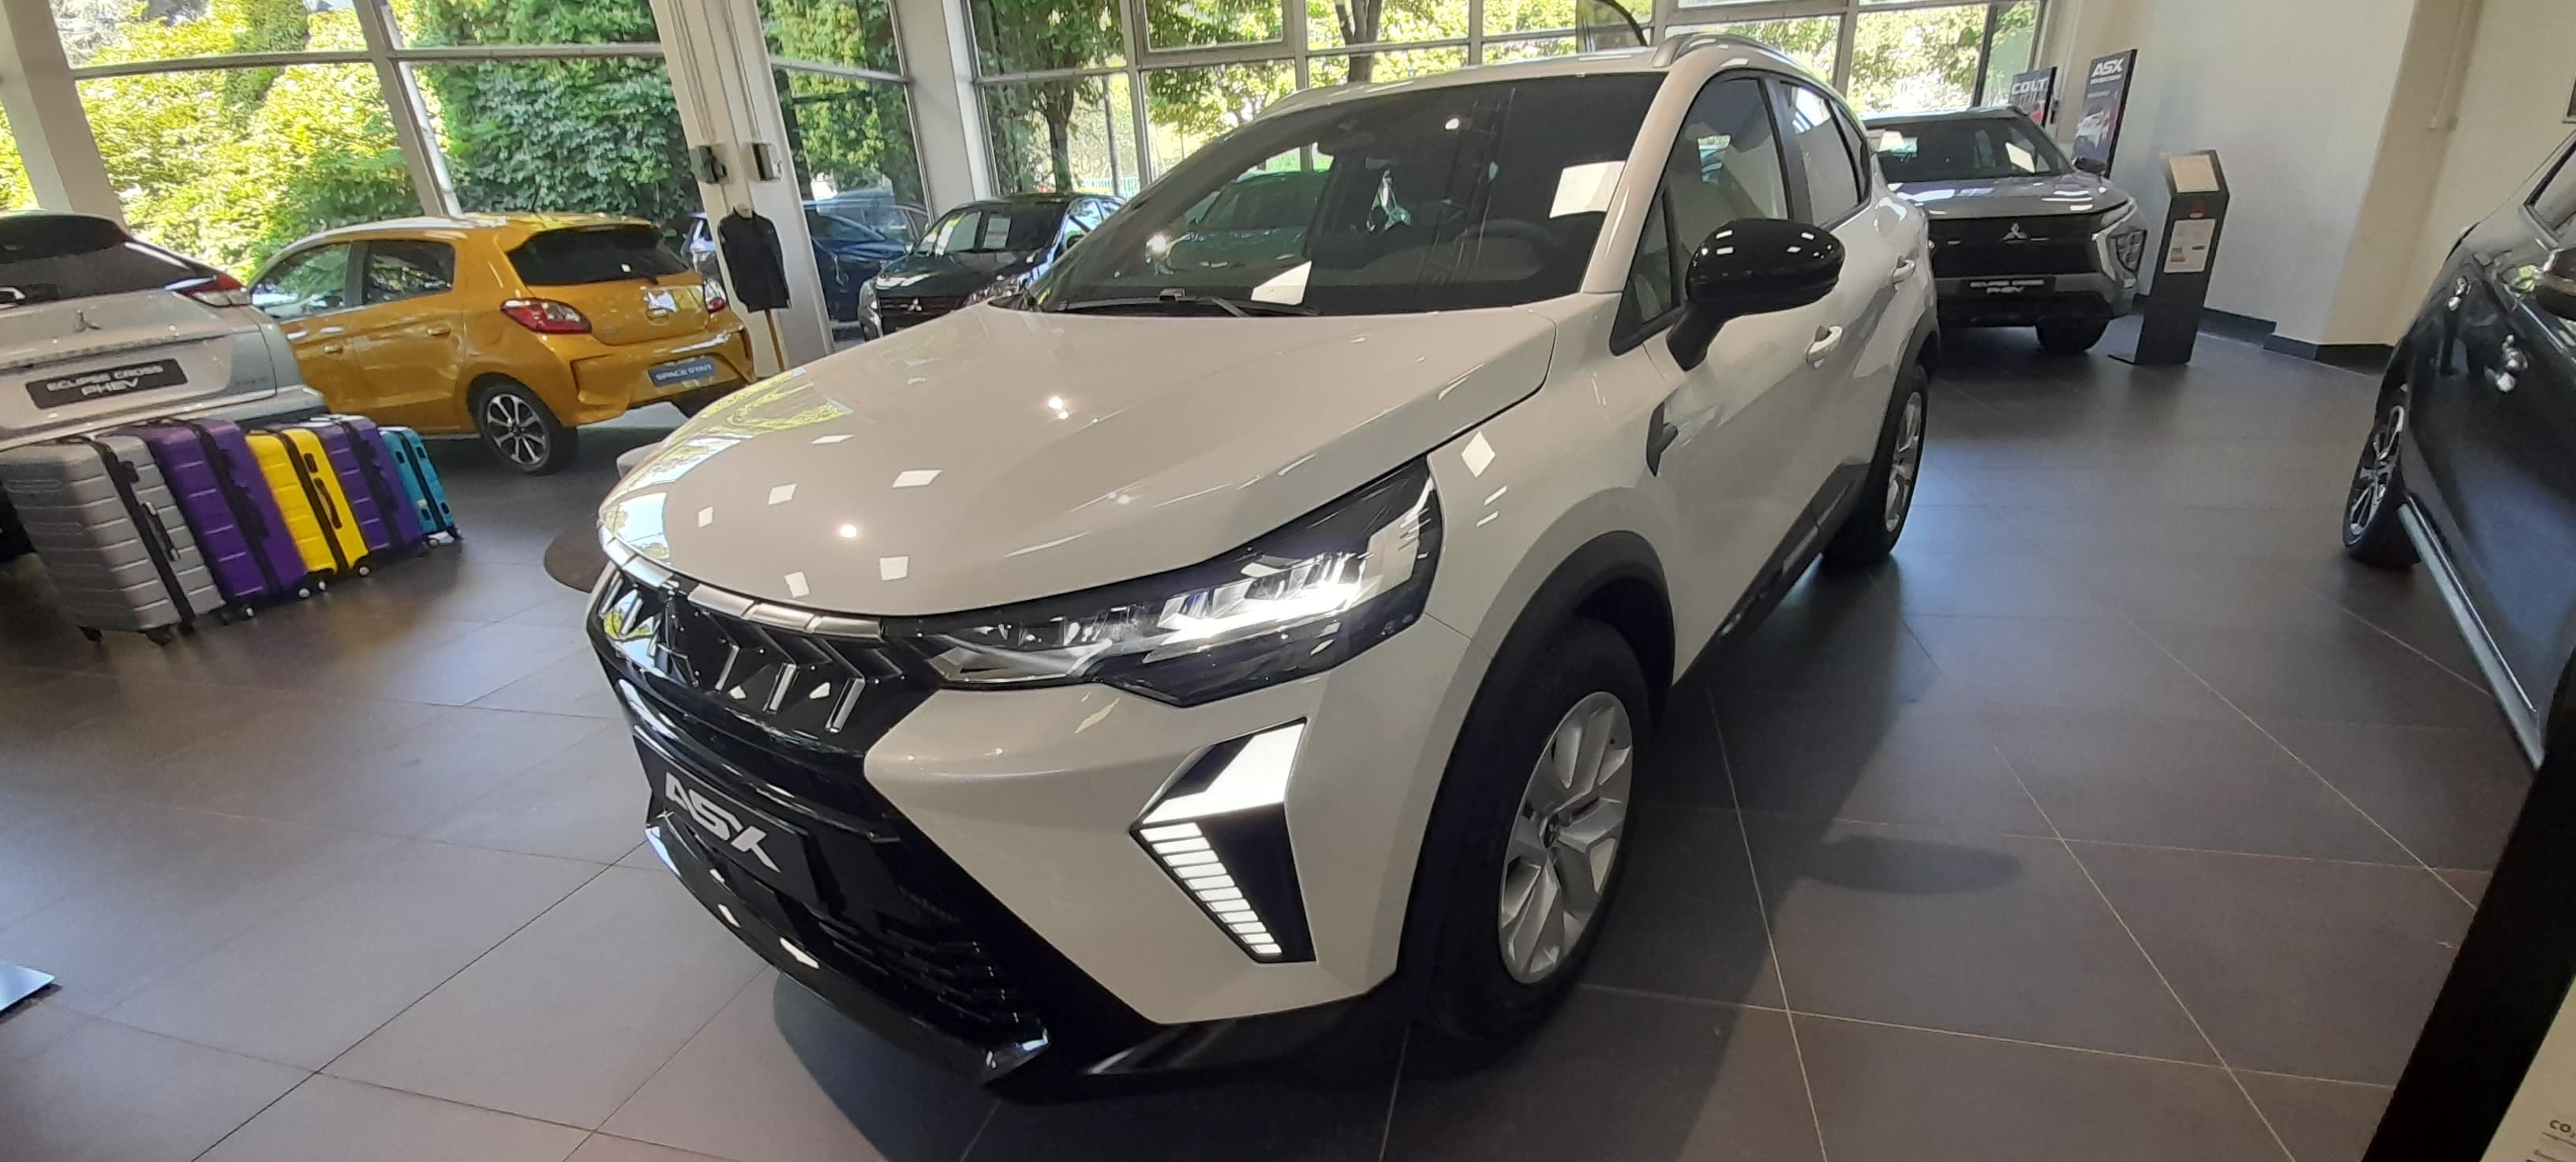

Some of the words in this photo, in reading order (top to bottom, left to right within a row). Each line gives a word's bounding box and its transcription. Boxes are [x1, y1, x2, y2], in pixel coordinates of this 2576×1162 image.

[2091, 58, 2125, 77] ASX
[2011, 77, 2050, 96] COLT
[46, 373, 111, 392] ECLIPSE
[114, 365, 164, 380] CROSS
[655, 369, 687, 380] SPACE
[80, 377, 139, 396] PHEV
[665, 771, 781, 874] ASX
